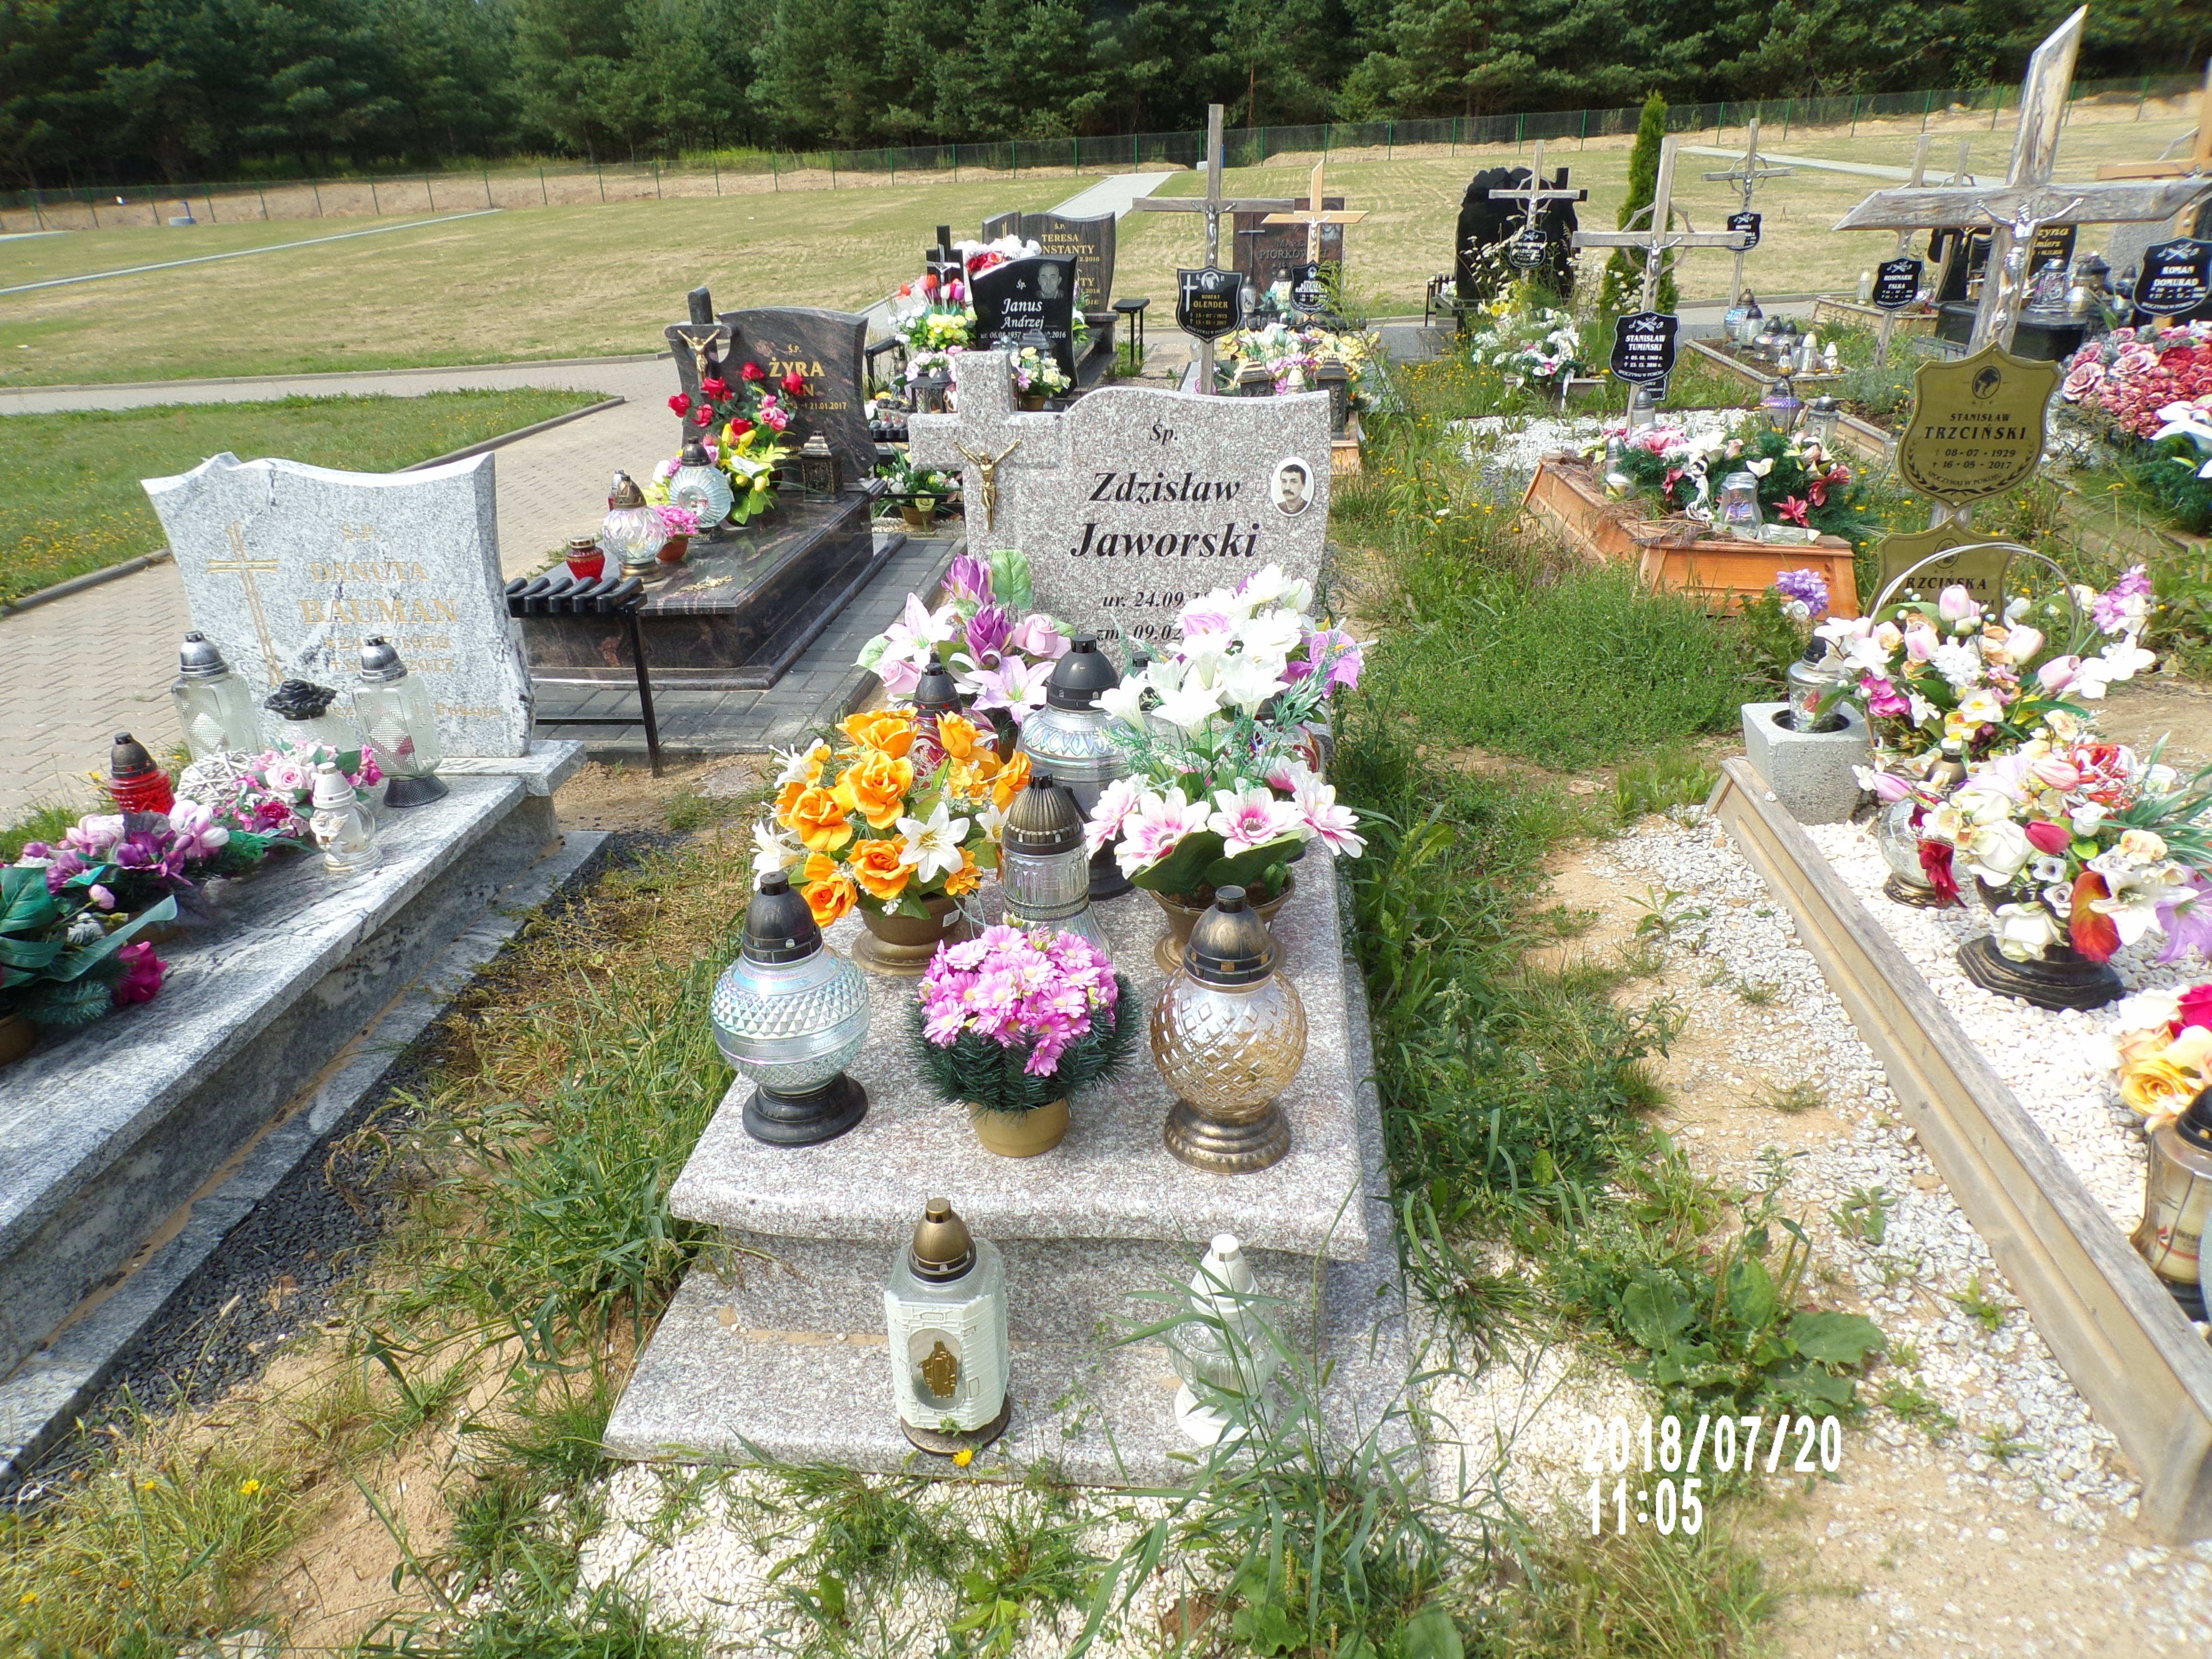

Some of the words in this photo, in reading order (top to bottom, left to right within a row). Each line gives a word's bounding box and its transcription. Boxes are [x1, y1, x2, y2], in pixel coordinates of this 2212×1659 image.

[1041, 234, 1079, 242] TERESA
[1042, 245, 1094, 254] NSTANTY
[2161, 265, 2195, 275] ROMAN
[1001, 298, 1043, 314] Janus
[1000, 316, 1045, 329] Andrzej
[1628, 342, 1662, 351] TUMIŃSKI
[769, 356, 825, 377] ŻYRA
[810, 402, 847, 410] 21.01.2017
[1950, 413, 2010, 421] STANISŁAW
[1149, 419, 1178, 445] Śp.
[1924, 424, 2027, 440] TRZCIŃSKI
[1088, 472, 1240, 505] Zdzisław
[1070, 523, 1260, 557] Jaworski
[310, 561, 429, 582] DANUTA
[1906, 576, 1986, 590] RZCIŃSKA
[1103, 596, 1126, 607] ur.
[299, 598, 459, 624] BAUMAN
